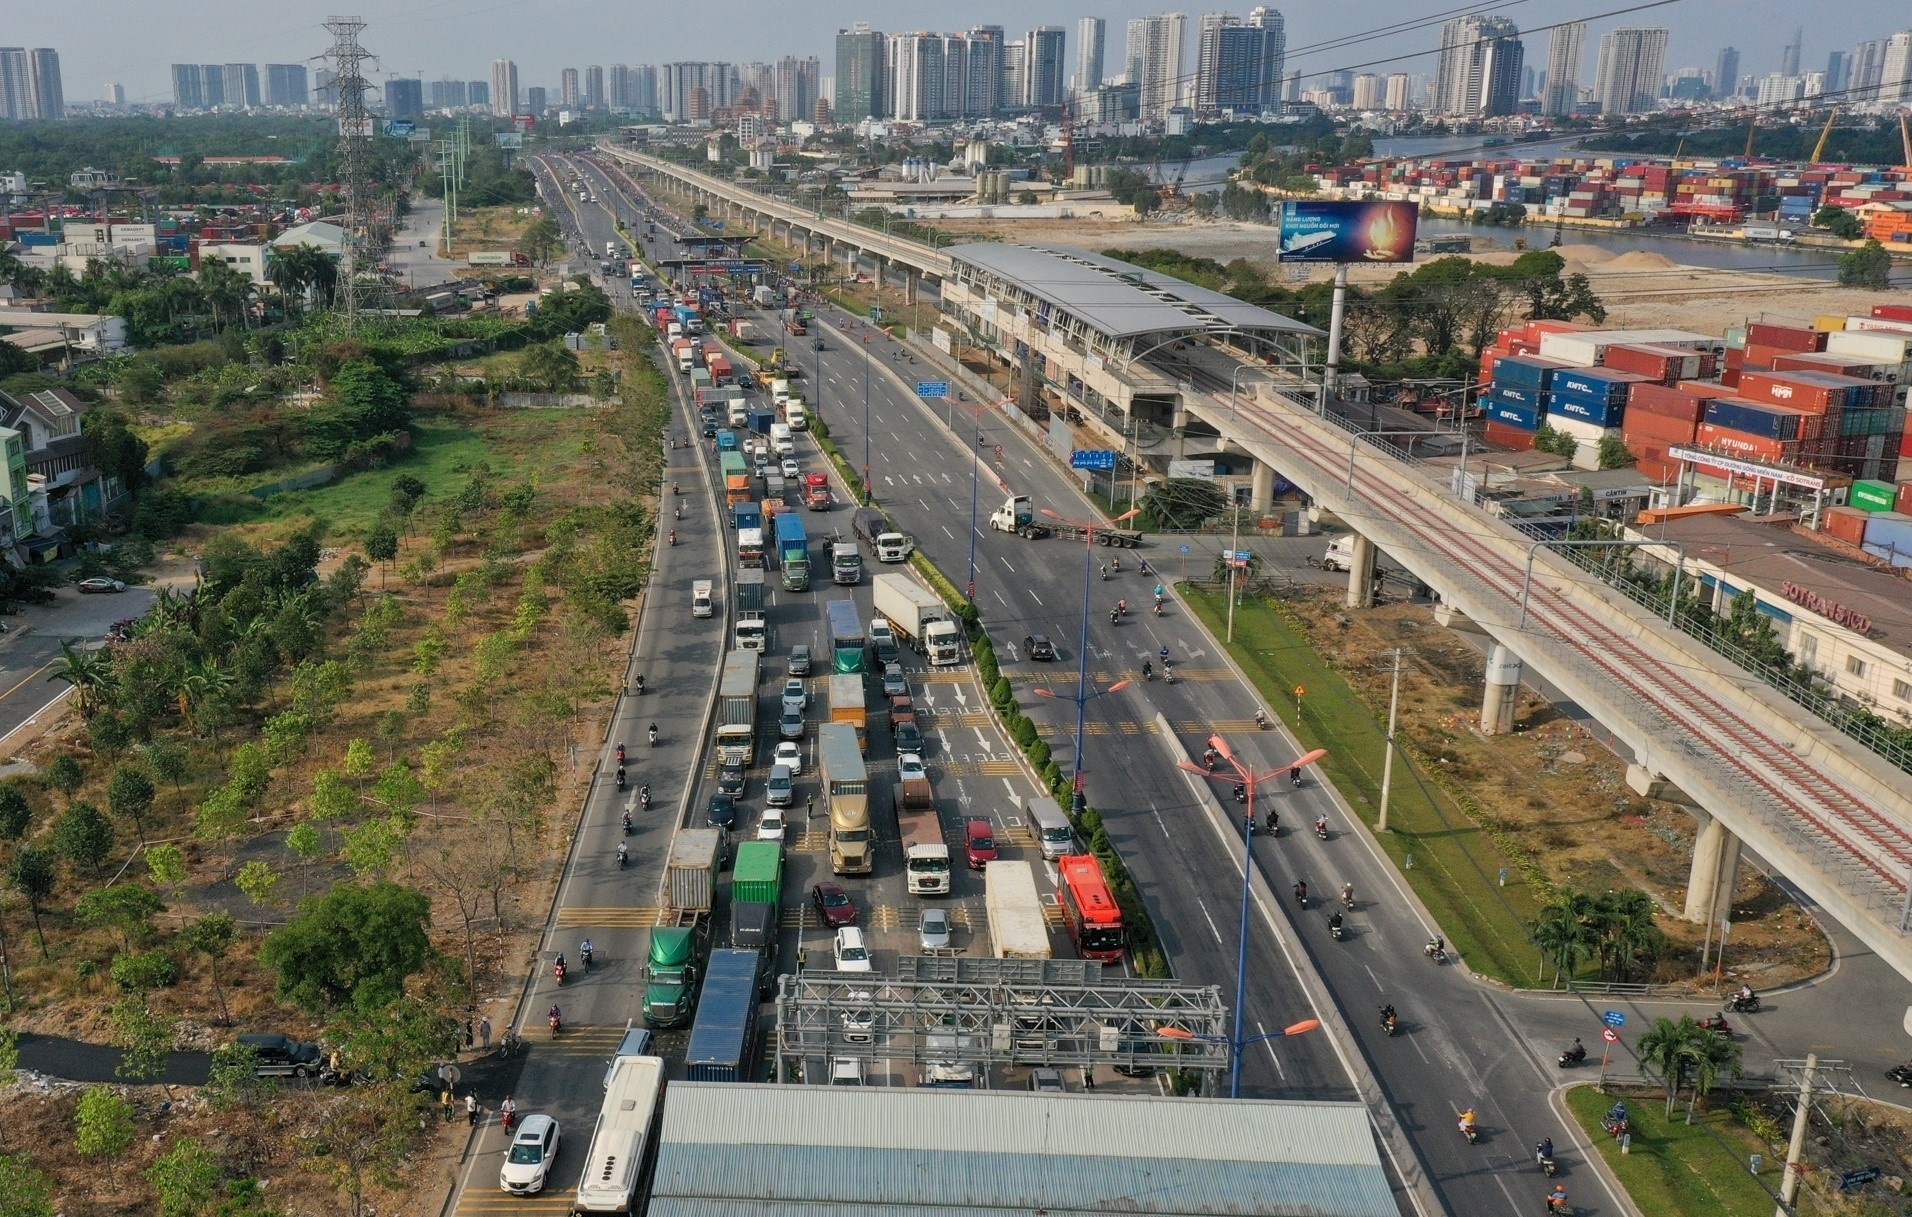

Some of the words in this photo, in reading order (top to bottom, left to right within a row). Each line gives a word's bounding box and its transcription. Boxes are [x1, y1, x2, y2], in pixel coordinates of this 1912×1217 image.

[1772, 384, 1793, 399] HMM
[1795, 476, 1821, 488] SOTRANS
[1781, 580, 1846, 622] SOTRANS
[1846, 609, 1872, 633] ICD
